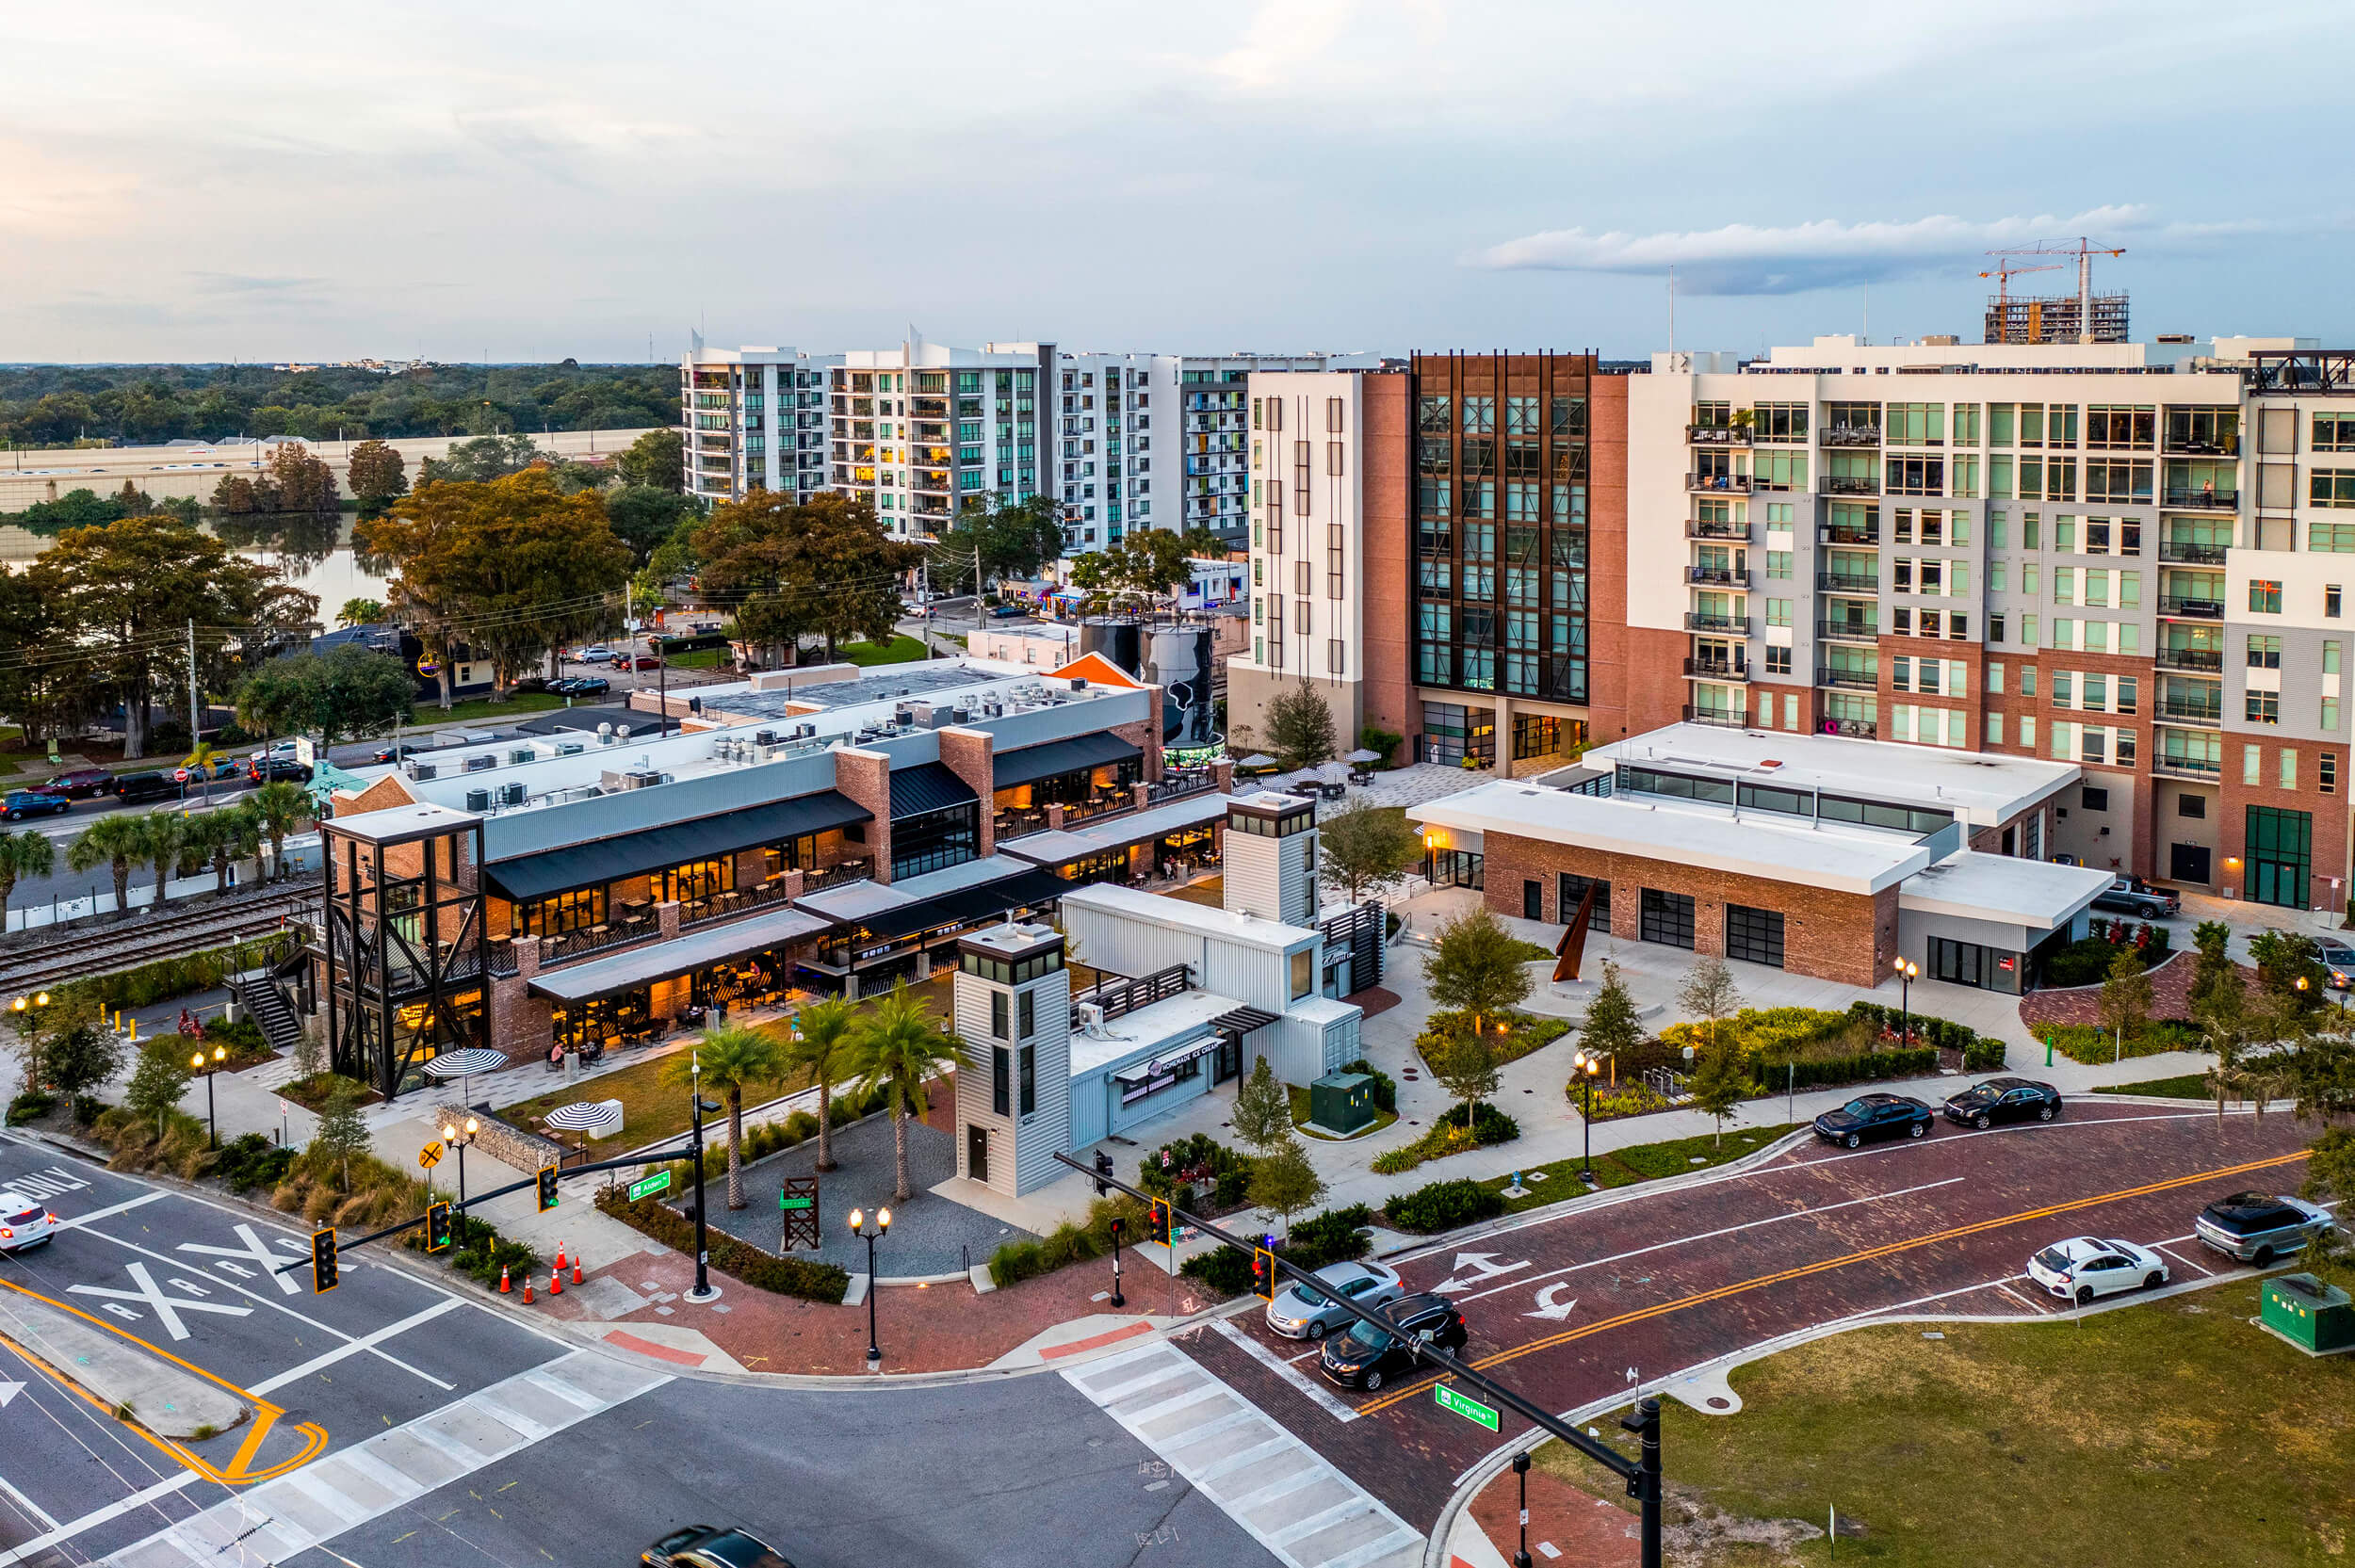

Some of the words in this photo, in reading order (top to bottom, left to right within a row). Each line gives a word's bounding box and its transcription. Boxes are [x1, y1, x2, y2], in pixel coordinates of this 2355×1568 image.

[1162, 1053, 1192, 1072] HOMEMADE
[1192, 1048, 1201, 1059] ICE
[1201, 1041, 1219, 1055] CREAM
[1, 1166, 92, 1201] ONLY
[642, 1179, 663, 1192] Alden
[215, 1260, 259, 1279] R
[167, 1277, 212, 1298] R
[101, 1302, 144, 1321] R
[1454, 1397, 1486, 1421] Virginia
